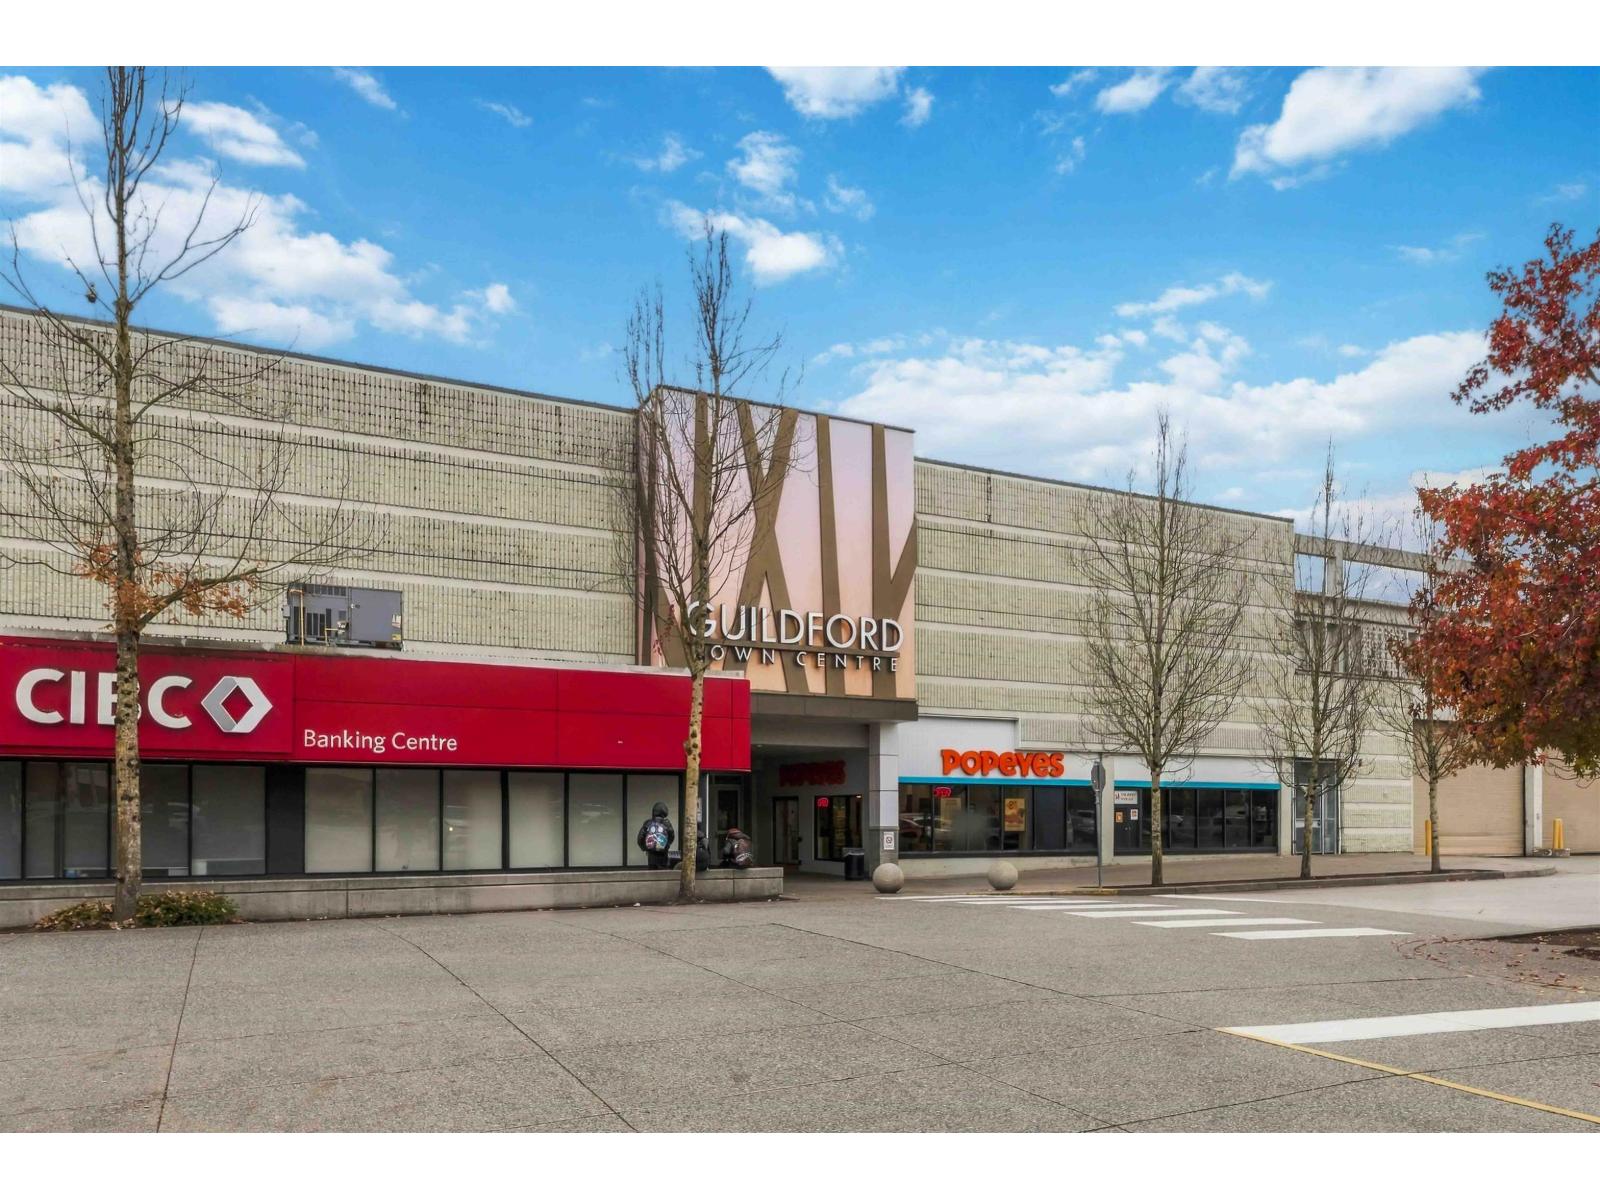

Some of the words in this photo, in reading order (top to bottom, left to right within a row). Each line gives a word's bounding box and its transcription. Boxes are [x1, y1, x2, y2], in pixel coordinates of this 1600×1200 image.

[687, 601, 904, 651] GUILDFORD
[710, 645, 775, 665] OWN
[796, 651, 897, 672] CENTRE
[304, 729, 386, 753] Banking
[391, 732, 457, 751] Centre
